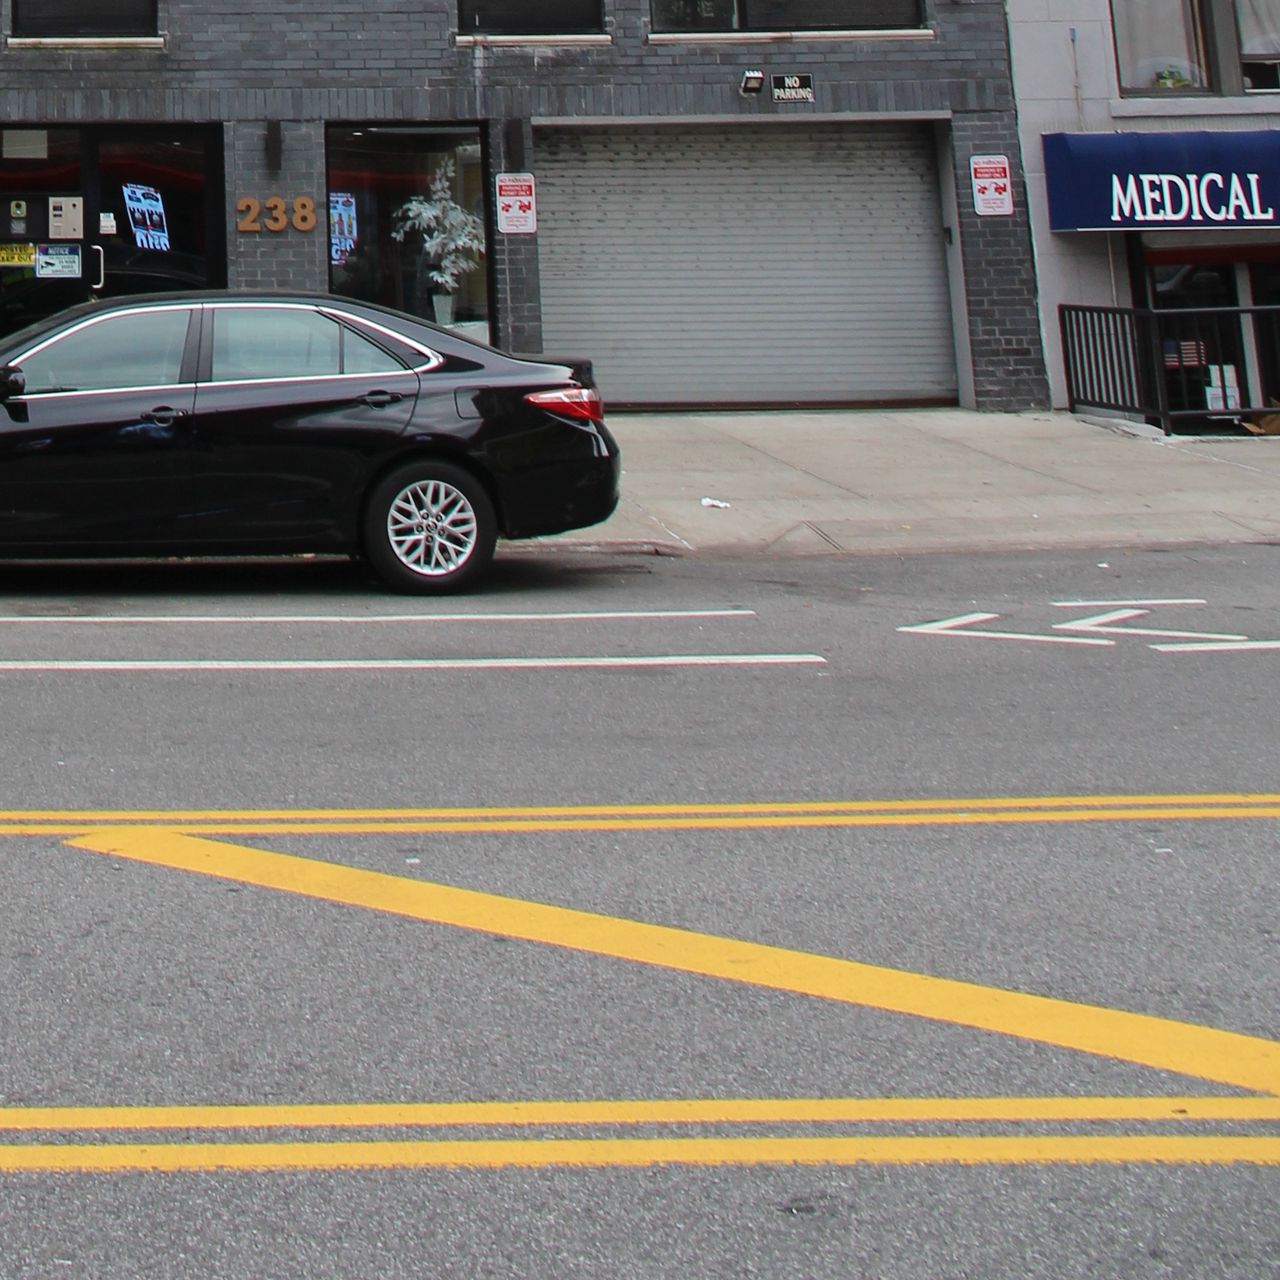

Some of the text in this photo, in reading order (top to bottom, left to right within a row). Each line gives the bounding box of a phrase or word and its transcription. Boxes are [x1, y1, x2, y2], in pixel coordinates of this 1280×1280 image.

[784, 76, 800, 88] NO
[773, 87, 813, 100] PARKING
[1111, 173, 1274, 221] MEDICAL
[236, 196, 318, 232] 238
[47, 246, 70, 254] NOTICE
